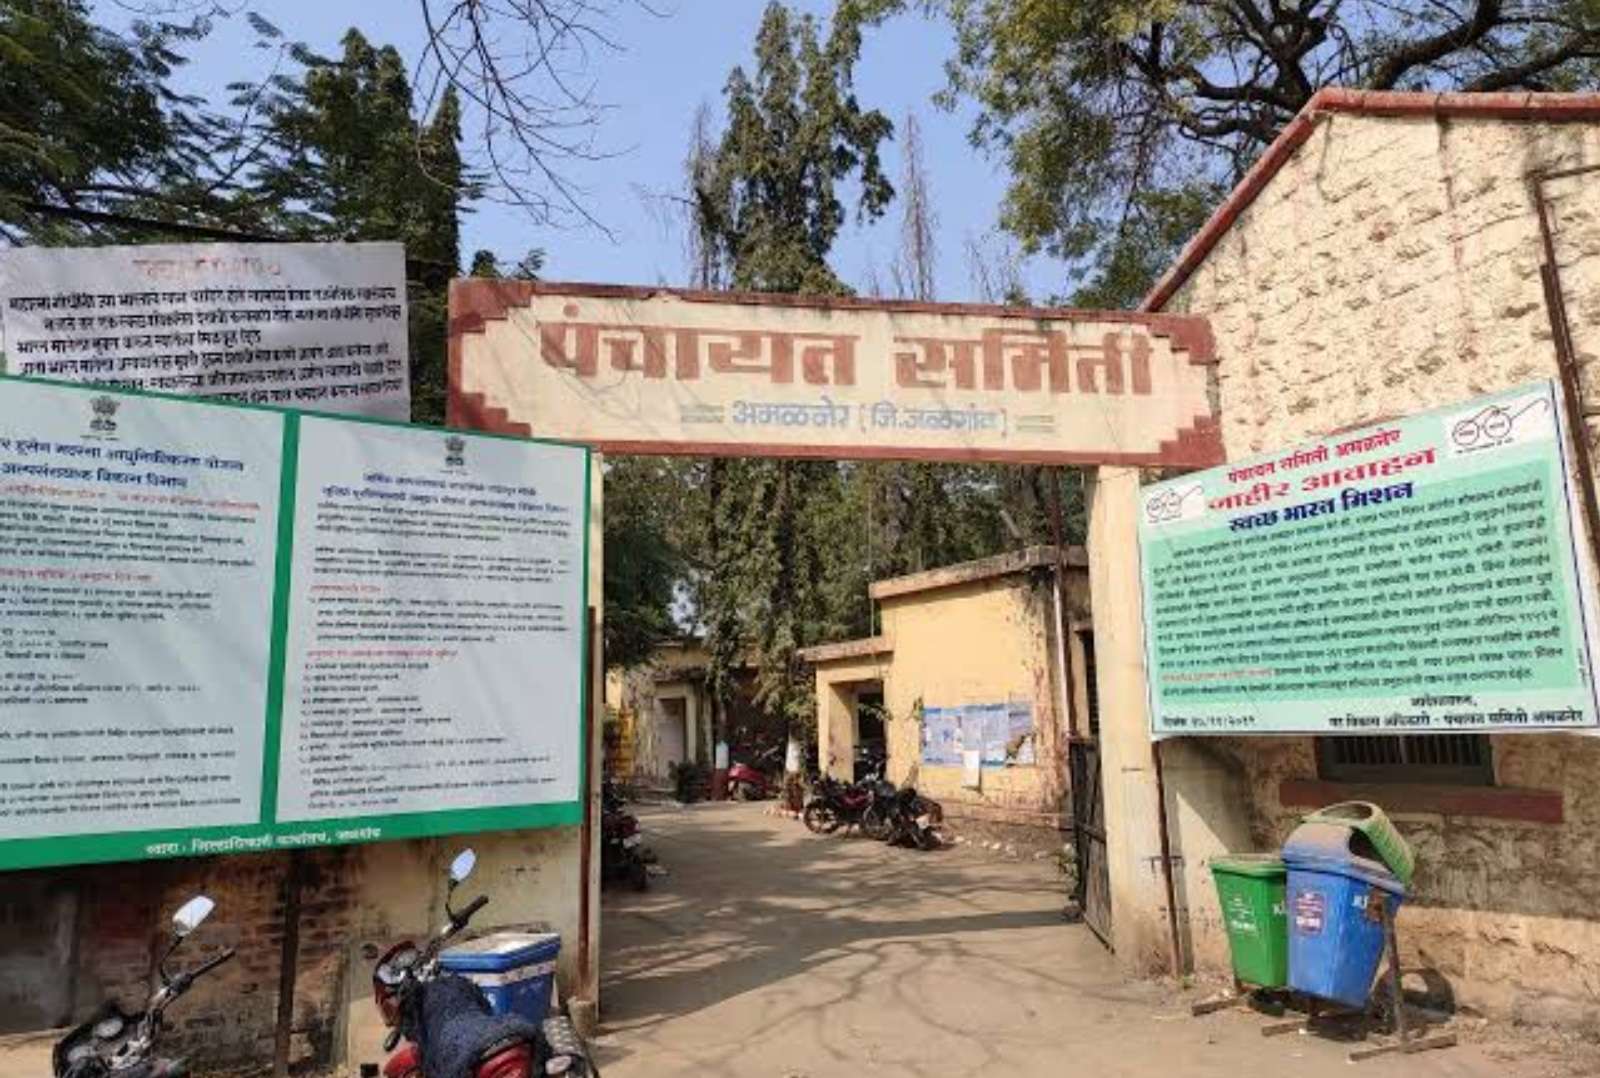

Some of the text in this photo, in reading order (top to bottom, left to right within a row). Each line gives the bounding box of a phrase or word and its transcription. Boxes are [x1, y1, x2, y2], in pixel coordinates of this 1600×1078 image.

[535, 304, 1154, 395] पंचायत समिती
[732, 396, 850, 427] अमळनेर
[1209, 447, 1436, 509] जाहीर आवाहन
[1229, 480, 1415, 533] स्वच्छ भारत मिशन
